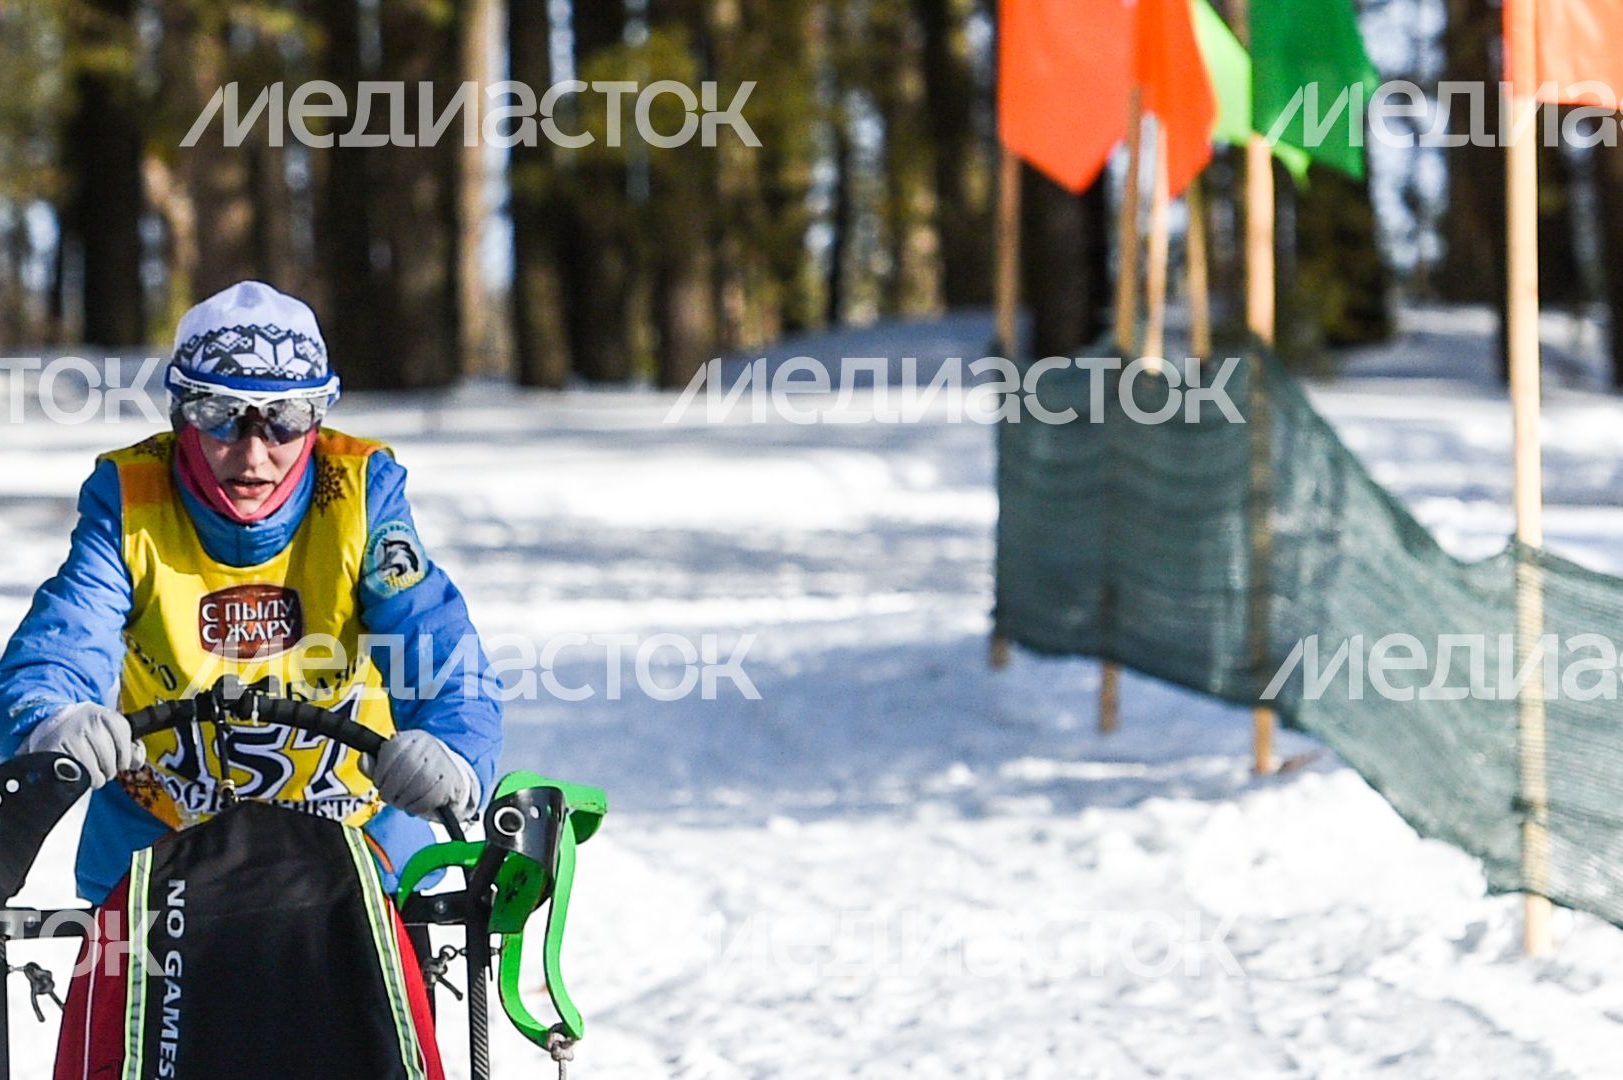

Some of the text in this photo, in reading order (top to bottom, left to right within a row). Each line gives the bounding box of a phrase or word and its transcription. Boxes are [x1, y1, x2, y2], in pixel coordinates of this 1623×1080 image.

[201, 598, 294, 623] С ПЫЛУ
[202, 619, 294, 644] С ЖАРУ
[166, 878, 186, 939] NO
